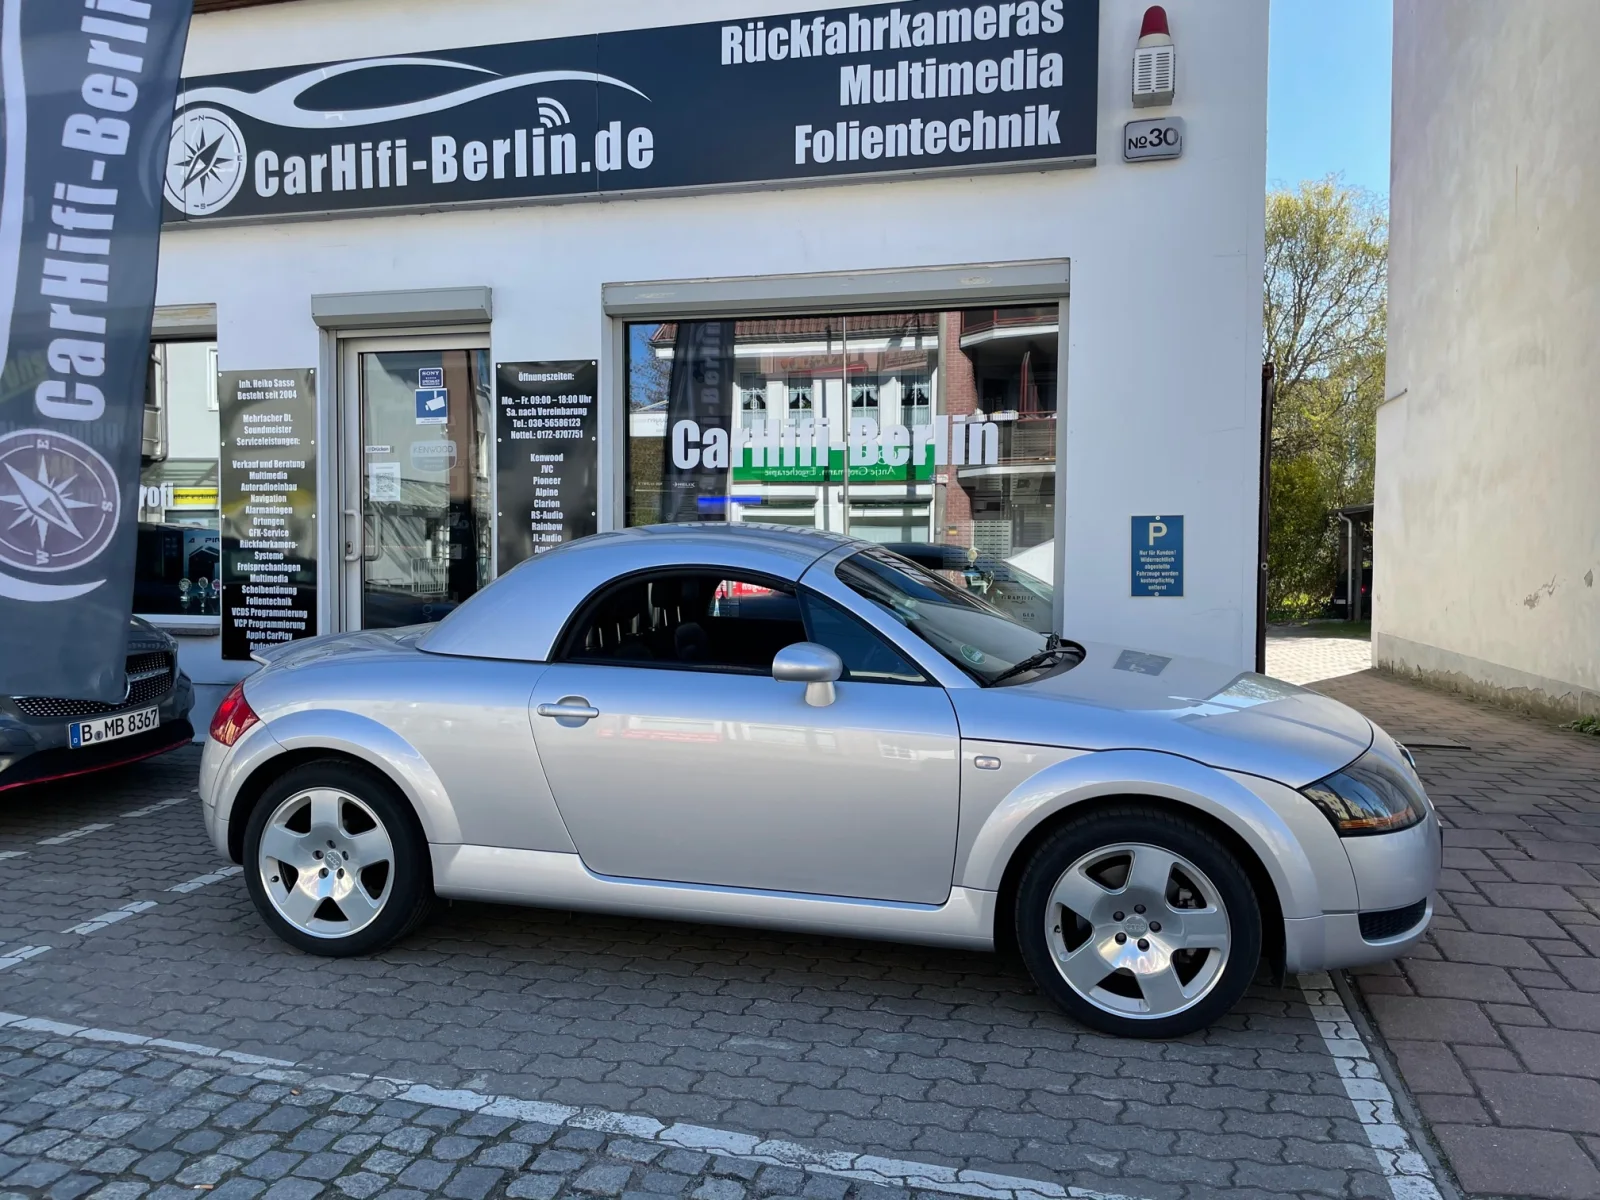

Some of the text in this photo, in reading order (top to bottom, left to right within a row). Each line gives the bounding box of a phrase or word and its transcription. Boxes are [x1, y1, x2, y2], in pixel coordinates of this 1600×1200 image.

[721, 0, 1064, 65] Rückfahrkameras
[840, 48, 1063, 106] Multimedia
[795, 104, 1061, 165] Folientechnik
[254, 121, 654, 199] CarHifi-Berlin.de
[518, 372, 575, 382] Öffnungszeiten:
[239, 378, 295, 389] Inh. Heiko Sasse
[237, 390, 297, 400] Besteht seit 2004
[501, 396, 515, 405] Mo.
[521, 396, 529, 405] Fr.
[530, 395, 551, 404] 09:00
[558, 395, 578, 404] 18:00
[578, 395, 592, 404] Uhr
[506, 407, 588, 416] Sa. nach Vereinbarung
[243, 413, 283, 423] Mehrfacher
[244, 425, 292, 435] Soundmeister
[236, 437, 301, 447] Serviceleistungen:
[671, 414, 999, 470] CarHifi-Berlin
[530, 453, 564, 462] Kenwood
[232, 460, 305, 469] Verkauf und Beratung
[540, 464, 554, 474] JVC
[249, 471, 288, 480] Multimedia
[532, 476, 561, 485] Pioneer
[241, 482, 297, 492] Autoradioeinbau
[535, 488, 559, 497] Alpine
[250, 494, 287, 503] Navigation
[533, 499, 560, 508] Clarion
[245, 505, 293, 515] Alarmanlagen
[531, 510, 563, 520] RS-Audio
[253, 517, 285, 527] Ortungen
[531, 522, 563, 531] Rainbow
[248, 528, 289, 537] GFK-Service
[532, 533, 562, 542] JL-Audio
[1148, 522, 1168, 546] P
[240, 540, 298, 549] Rückfahrkamera-
[254, 551, 284, 560] Systeme
[237, 562, 301, 572] Freisprechanlagen
[249, 574, 289, 583] Multimedia
[241, 585, 297, 595] Scheibentönung
[246, 596, 292, 606] Folientechnik
[231, 607, 308, 619] VCDS Programmierung
[234, 618, 306, 630] VCP Programmierung
[246, 631, 293, 641] Apple CarPlay
[81, 709, 158, 743] B MB 8367
